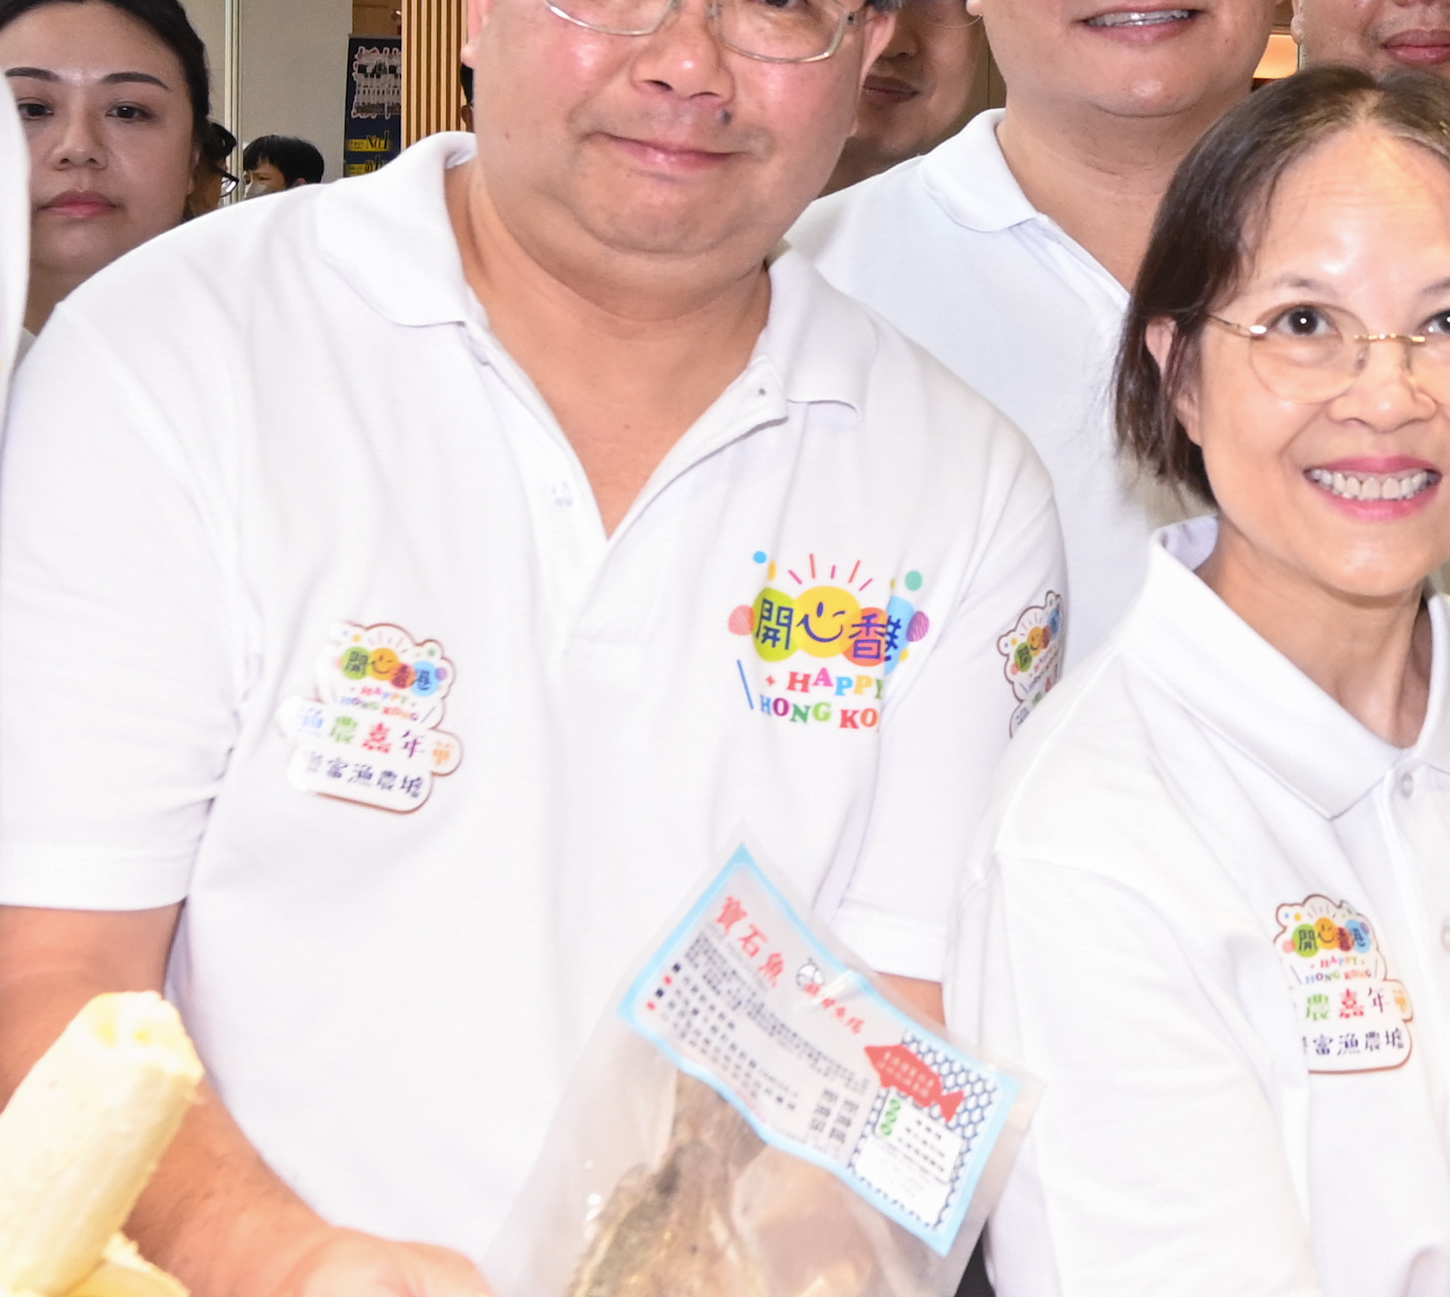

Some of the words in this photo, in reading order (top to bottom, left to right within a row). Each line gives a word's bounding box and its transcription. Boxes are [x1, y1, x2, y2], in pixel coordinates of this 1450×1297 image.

[759, 694, 832, 724] HONG
[717, 895, 786, 988] 寶石魚
